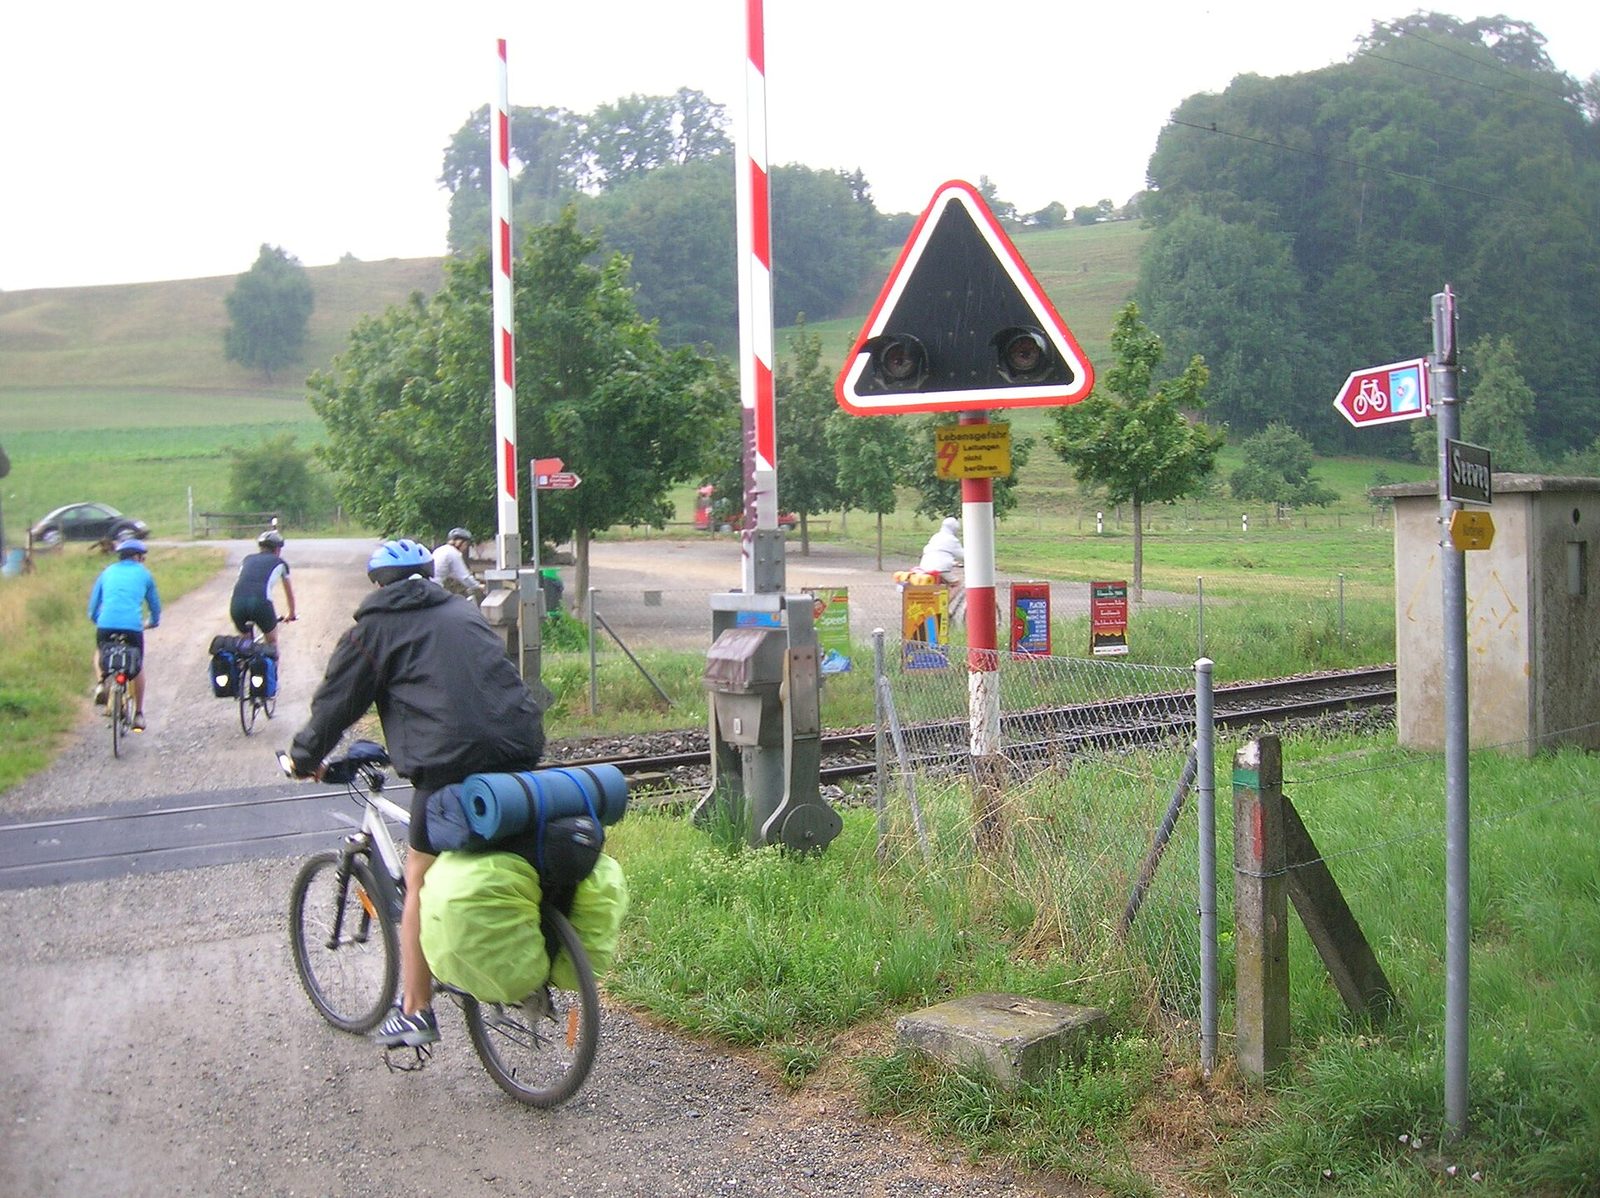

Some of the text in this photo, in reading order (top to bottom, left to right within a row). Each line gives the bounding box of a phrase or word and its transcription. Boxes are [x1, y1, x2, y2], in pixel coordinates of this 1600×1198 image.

[1398, 376, 1417, 411] 2
[938, 432, 1006, 441] Lebensgefahr
[1452, 448, 1489, 497] Seeweg
[820, 615, 847, 626] Speed
